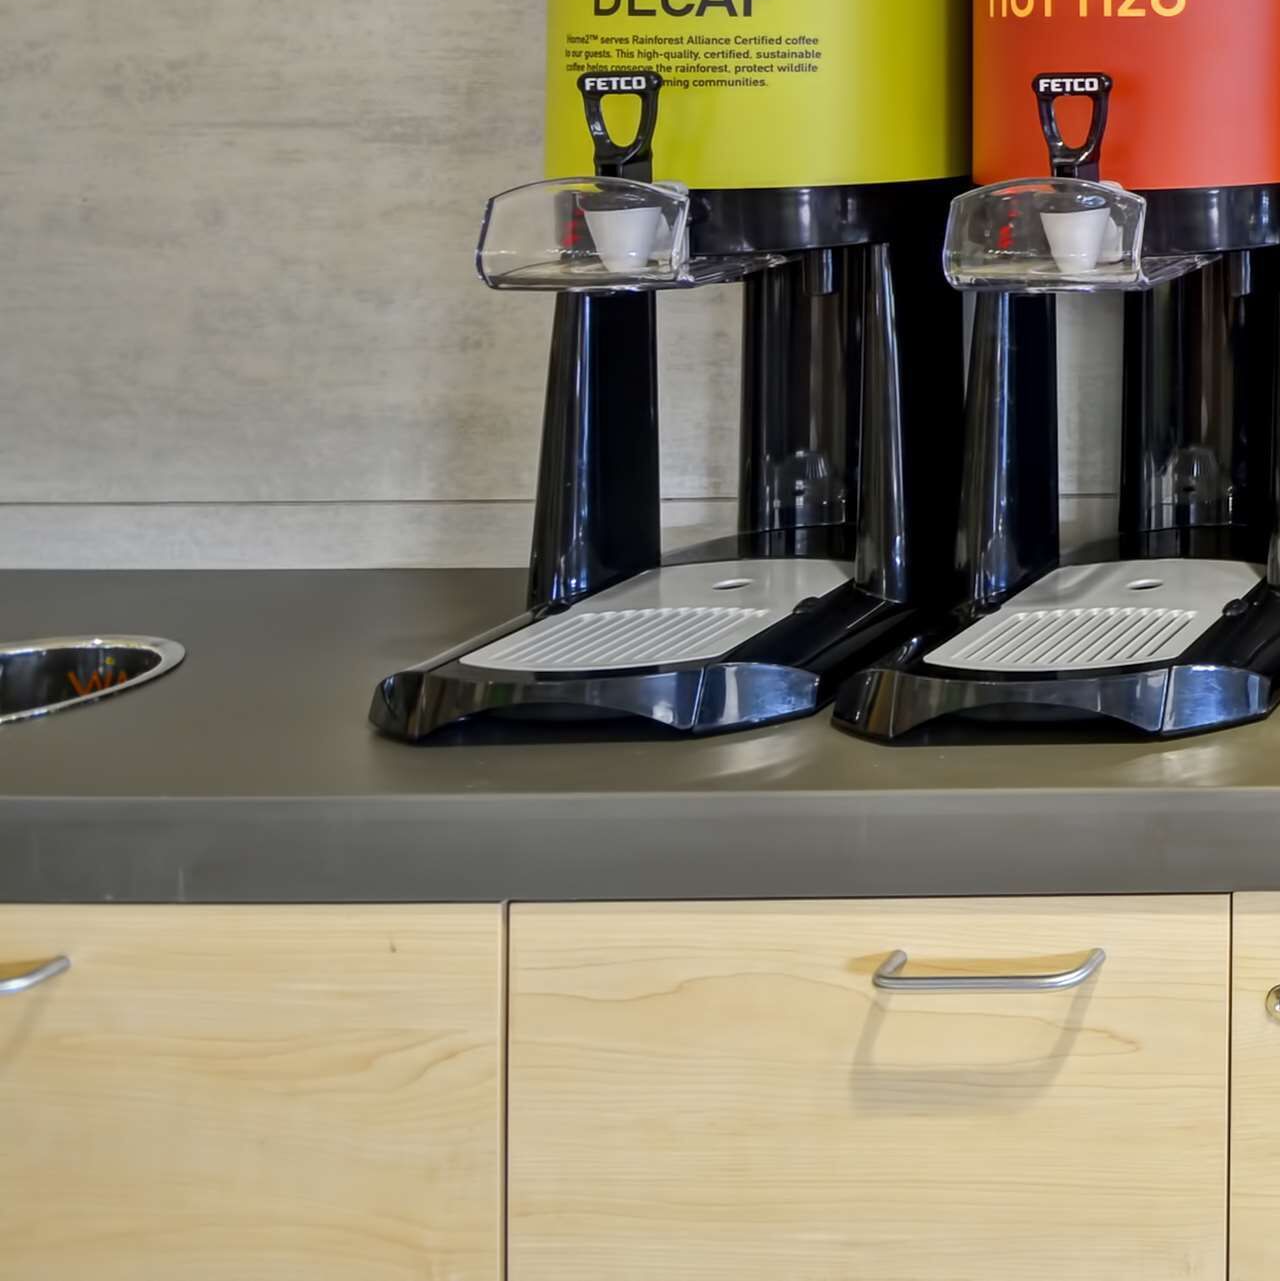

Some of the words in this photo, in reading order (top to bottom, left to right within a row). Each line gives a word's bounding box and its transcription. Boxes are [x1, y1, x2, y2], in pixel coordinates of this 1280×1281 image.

[600, 36, 630, 44] serves
[632, 35, 684, 45] Rainforest
[686, 35, 731, 45] Alliance
[734, 35, 782, 45] Certified
[785, 35, 819, 45] coffee
[615, 49, 635, 59] This
[755, 49, 822, 59] sustainable
[611, 64, 653, 72] conserve
[656, 63, 672, 72] the
[734, 64, 774, 75] protect
[777, 63, 818, 73] wildlife
[584, 76, 647, 91] FETCO
[1038, 78, 1099, 92] FETCO
